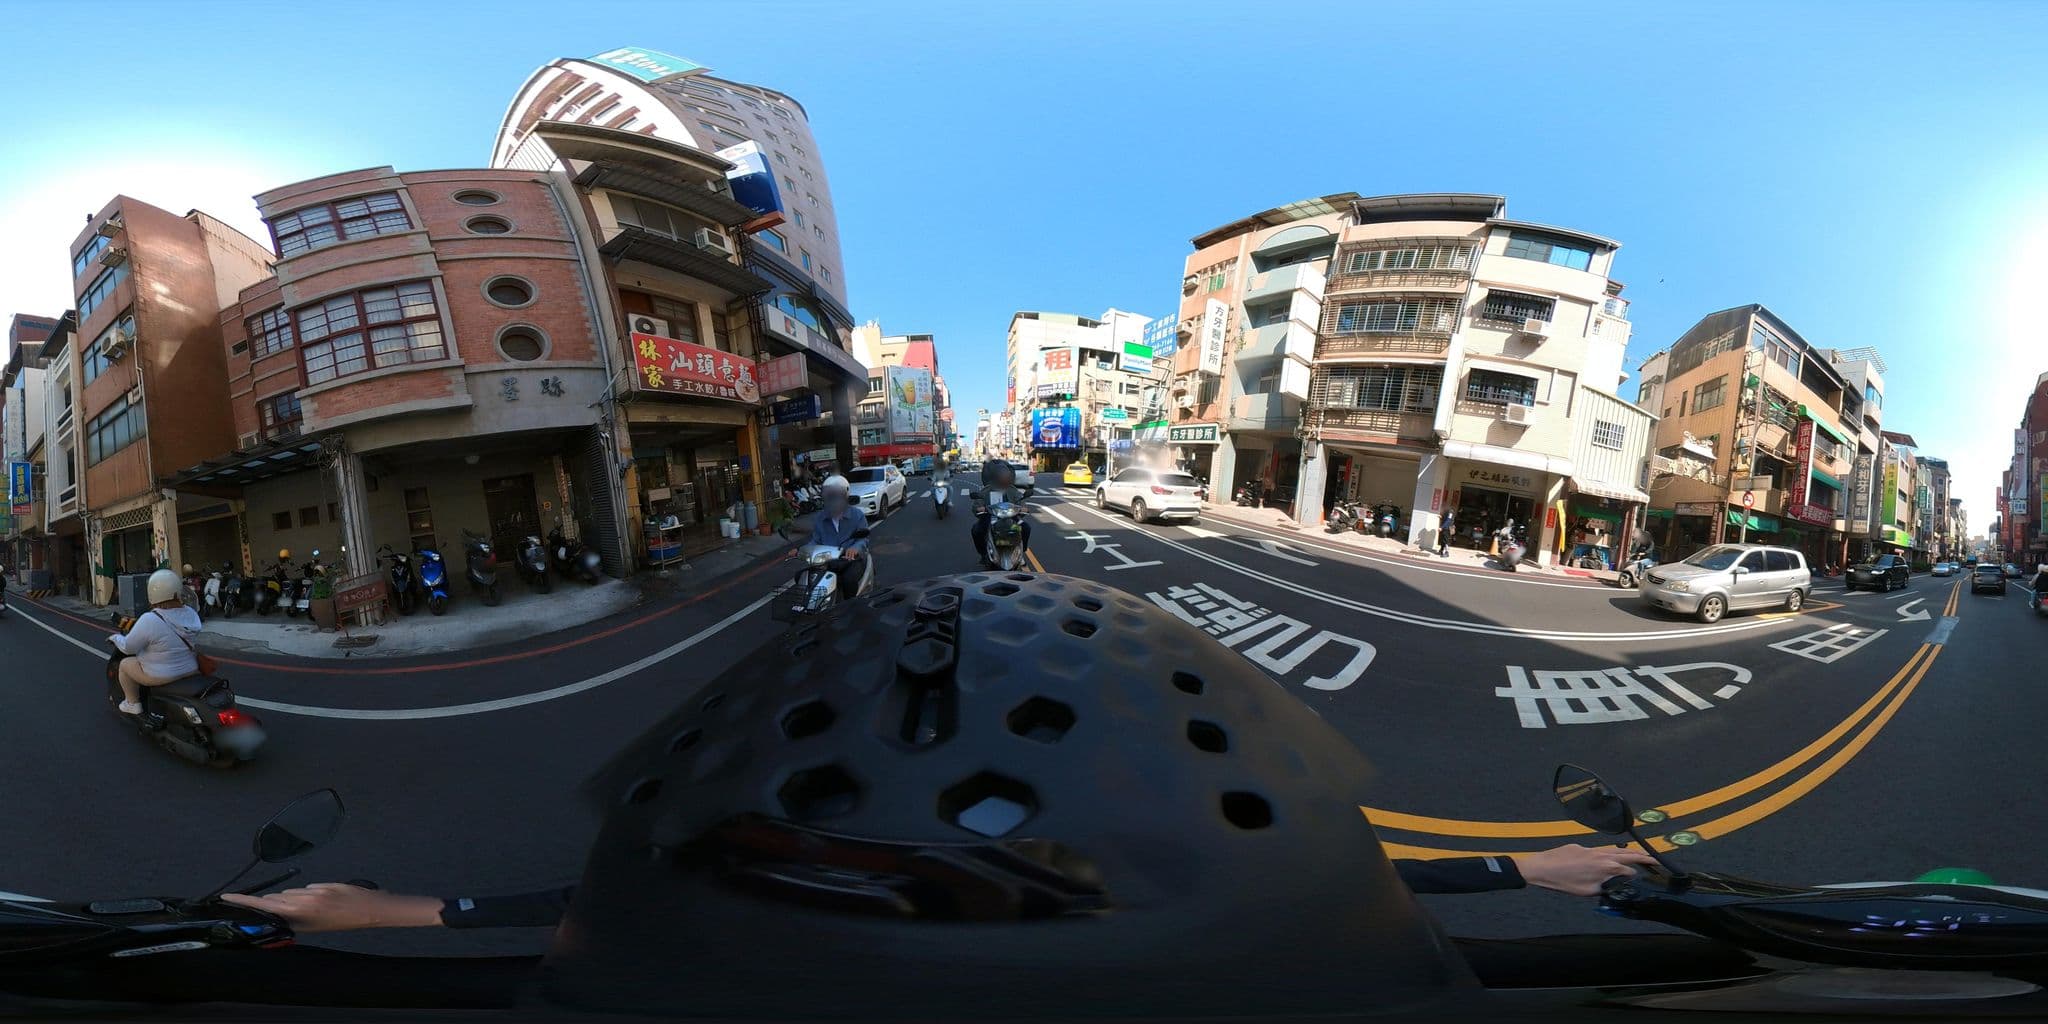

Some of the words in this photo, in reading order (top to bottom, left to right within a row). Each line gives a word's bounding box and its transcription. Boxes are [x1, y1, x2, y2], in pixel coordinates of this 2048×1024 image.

[1208, 306, 1224, 366] 方牙醫診所
[639, 339, 665, 388] 林家
[668, 345, 753, 386] 汕頭意麵
[1044, 349, 1072, 371] 租
[1171, 428, 1213, 441] 方牙醫診所
